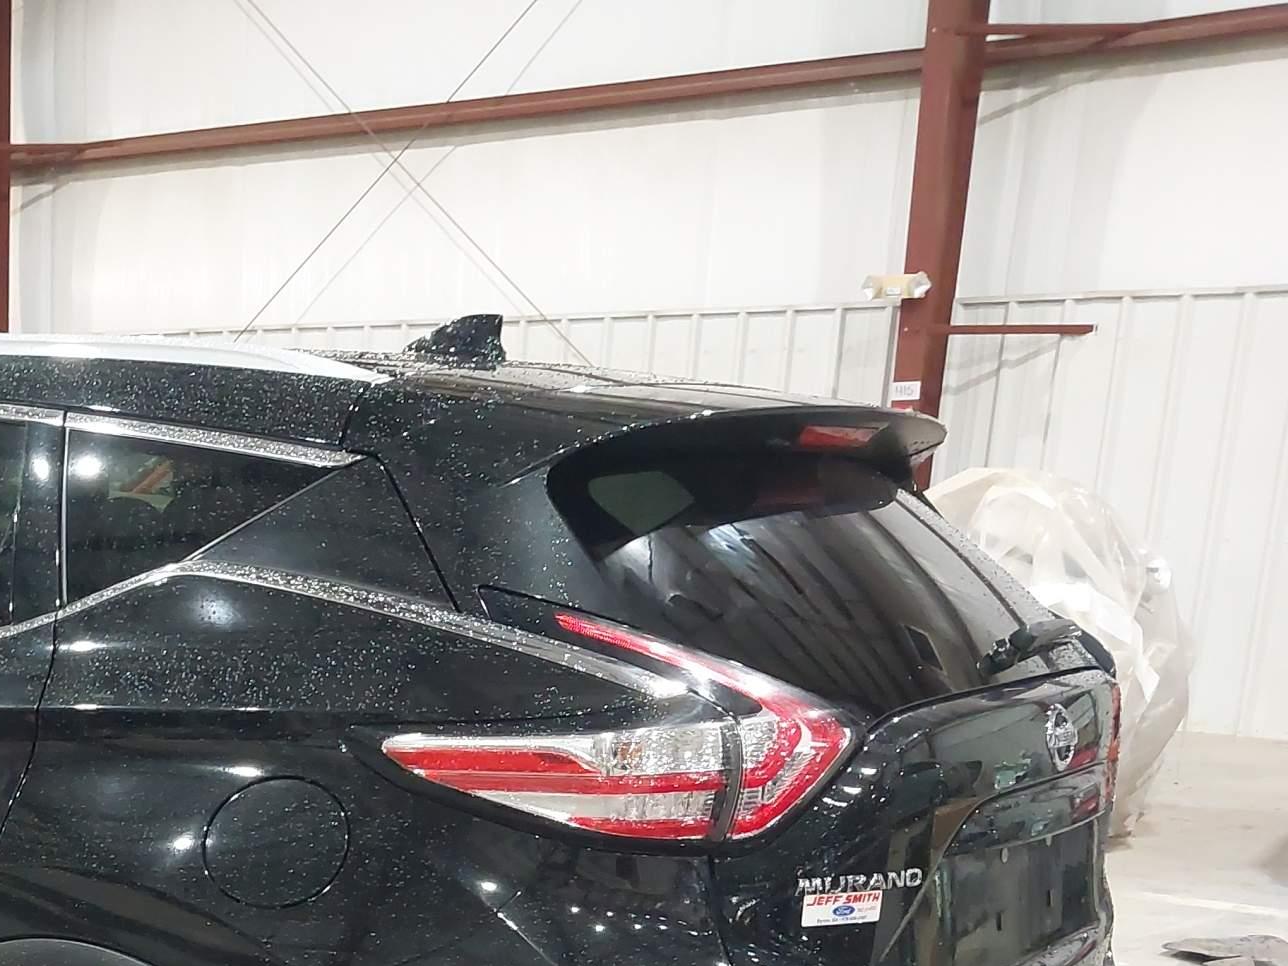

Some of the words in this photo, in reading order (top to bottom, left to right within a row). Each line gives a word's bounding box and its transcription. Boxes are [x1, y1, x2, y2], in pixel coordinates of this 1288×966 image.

[795, 868, 923, 896] MURANO
[806, 895, 842, 907] JEFF
[843, 892, 881, 905] SMITH
